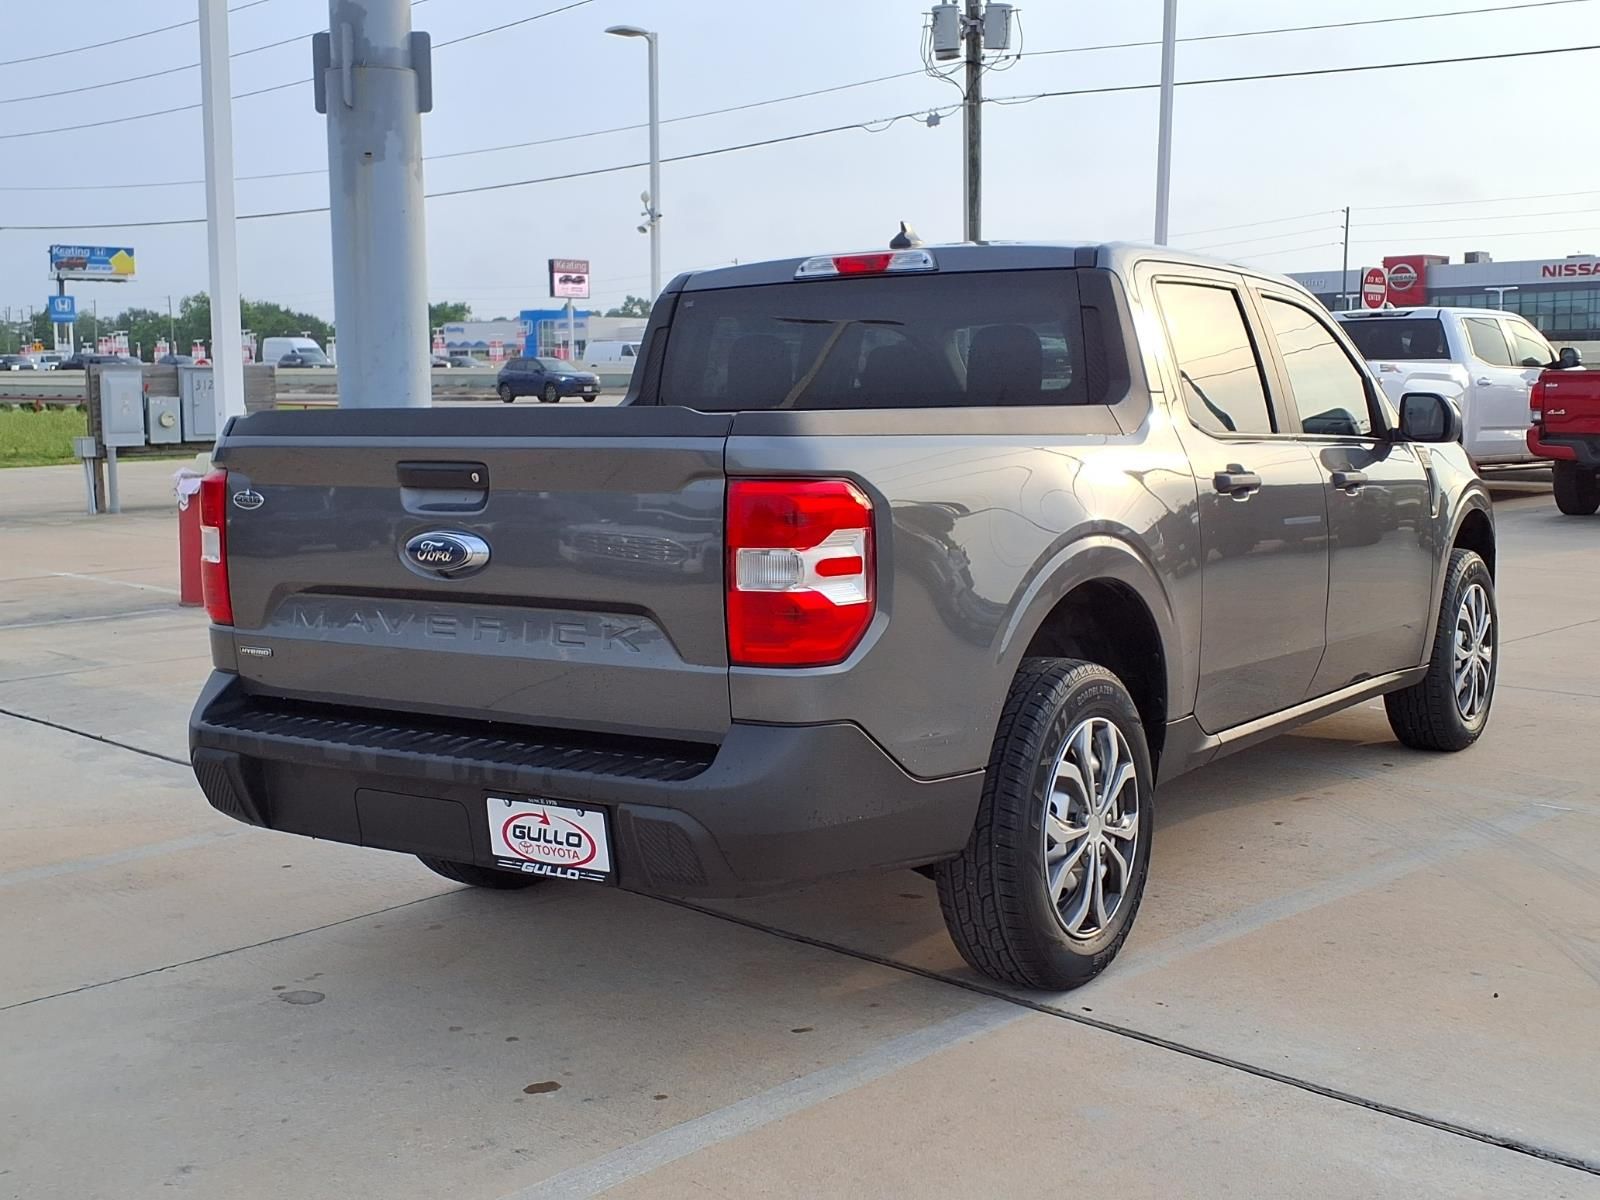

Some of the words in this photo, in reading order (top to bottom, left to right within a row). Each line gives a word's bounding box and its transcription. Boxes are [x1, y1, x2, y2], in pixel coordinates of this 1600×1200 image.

[53, 247, 90, 257] Keating
[417, 541, 453, 562] Ford
[292, 607, 641, 653] MAVERICK
[512, 824, 582, 848] GULLO
[536, 844, 580, 860] TOYOTA
[521, 862, 579, 880] GULLO
